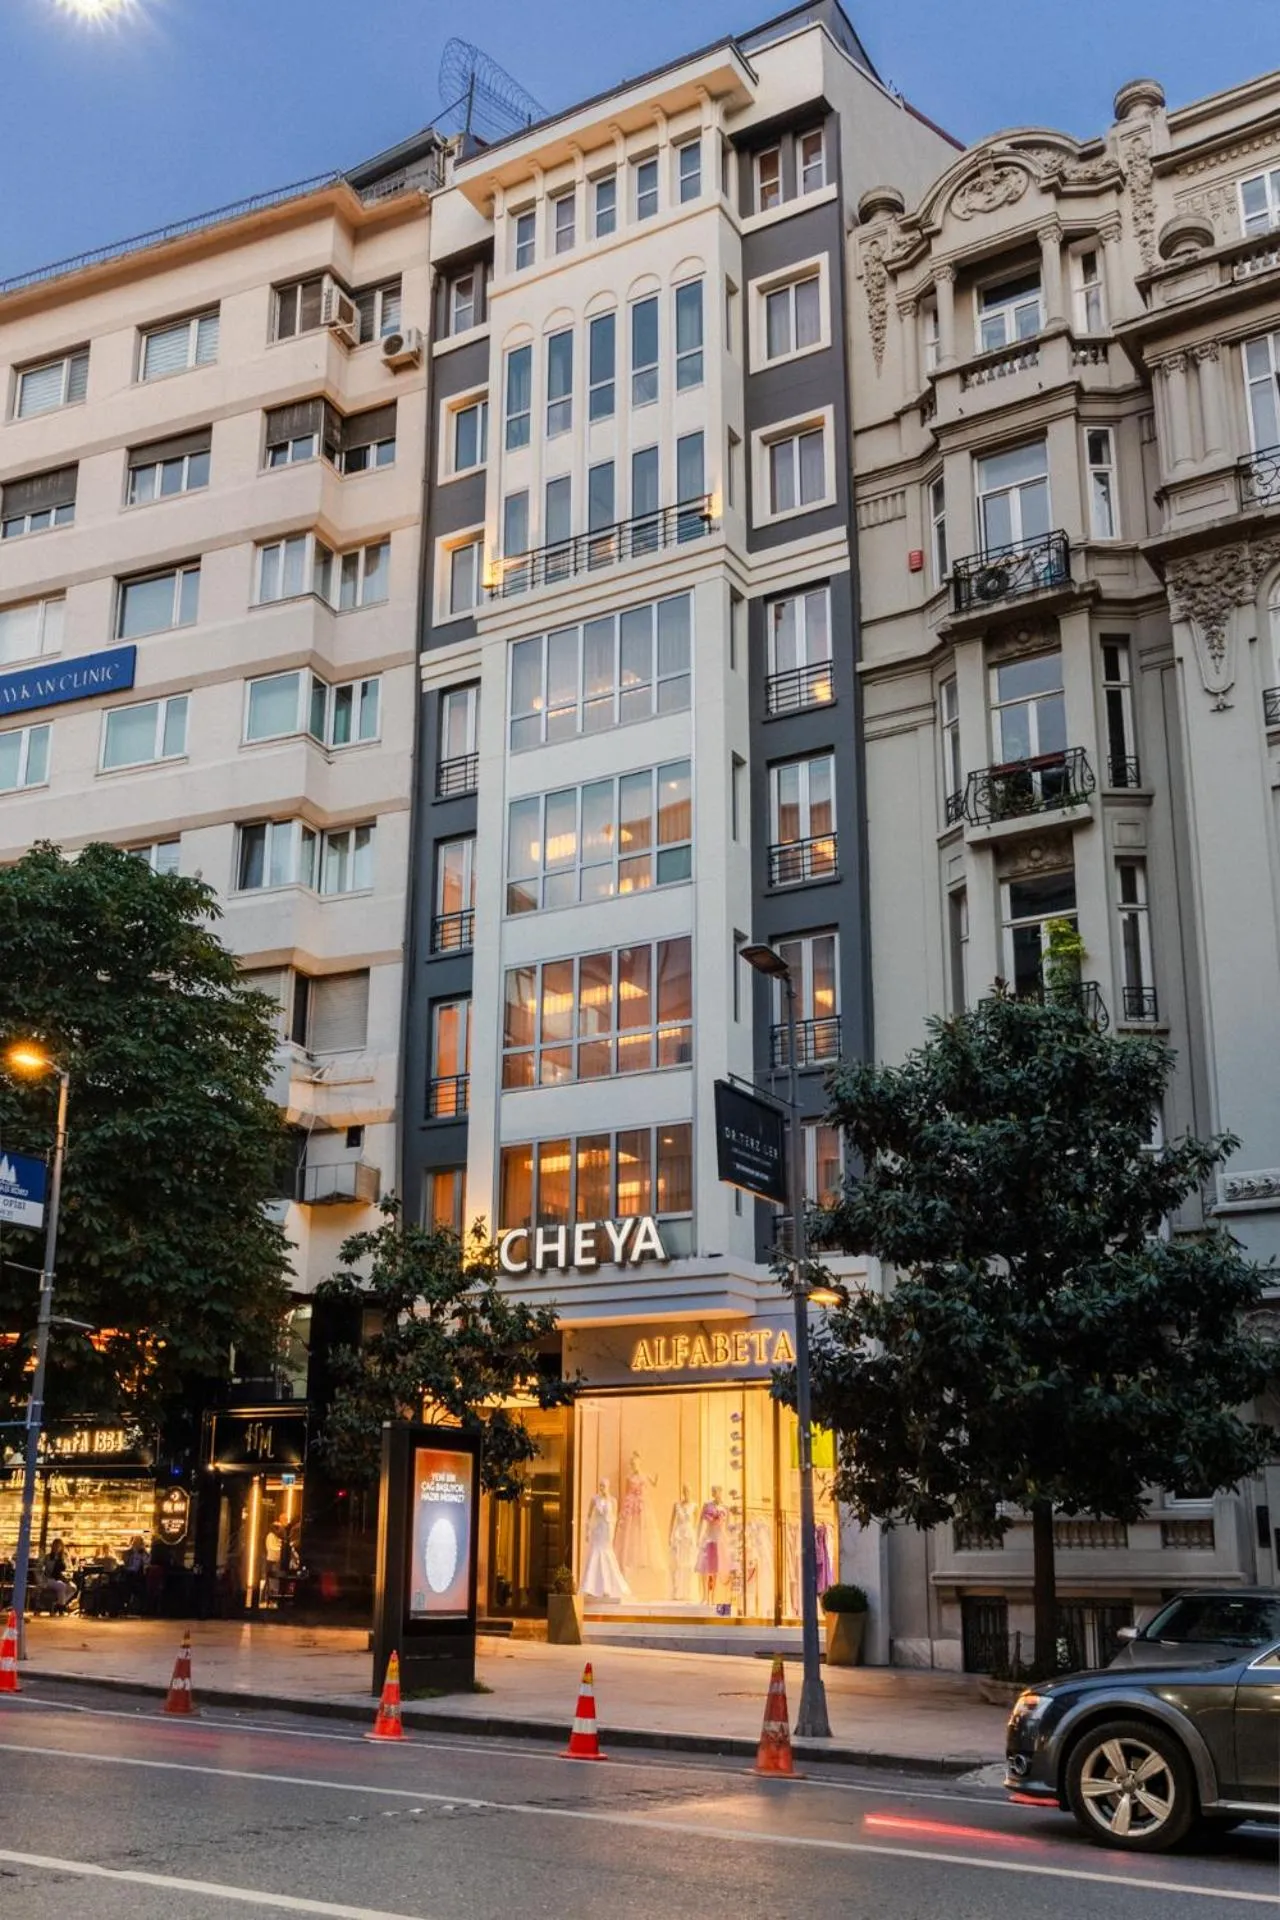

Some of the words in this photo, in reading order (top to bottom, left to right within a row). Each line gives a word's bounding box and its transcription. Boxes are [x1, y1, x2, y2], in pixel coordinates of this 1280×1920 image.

[59, 663, 120, 691] CLINIC
[500, 1216, 667, 1273] CHEYA
[631, 1330, 796, 1372] ALFABETA
